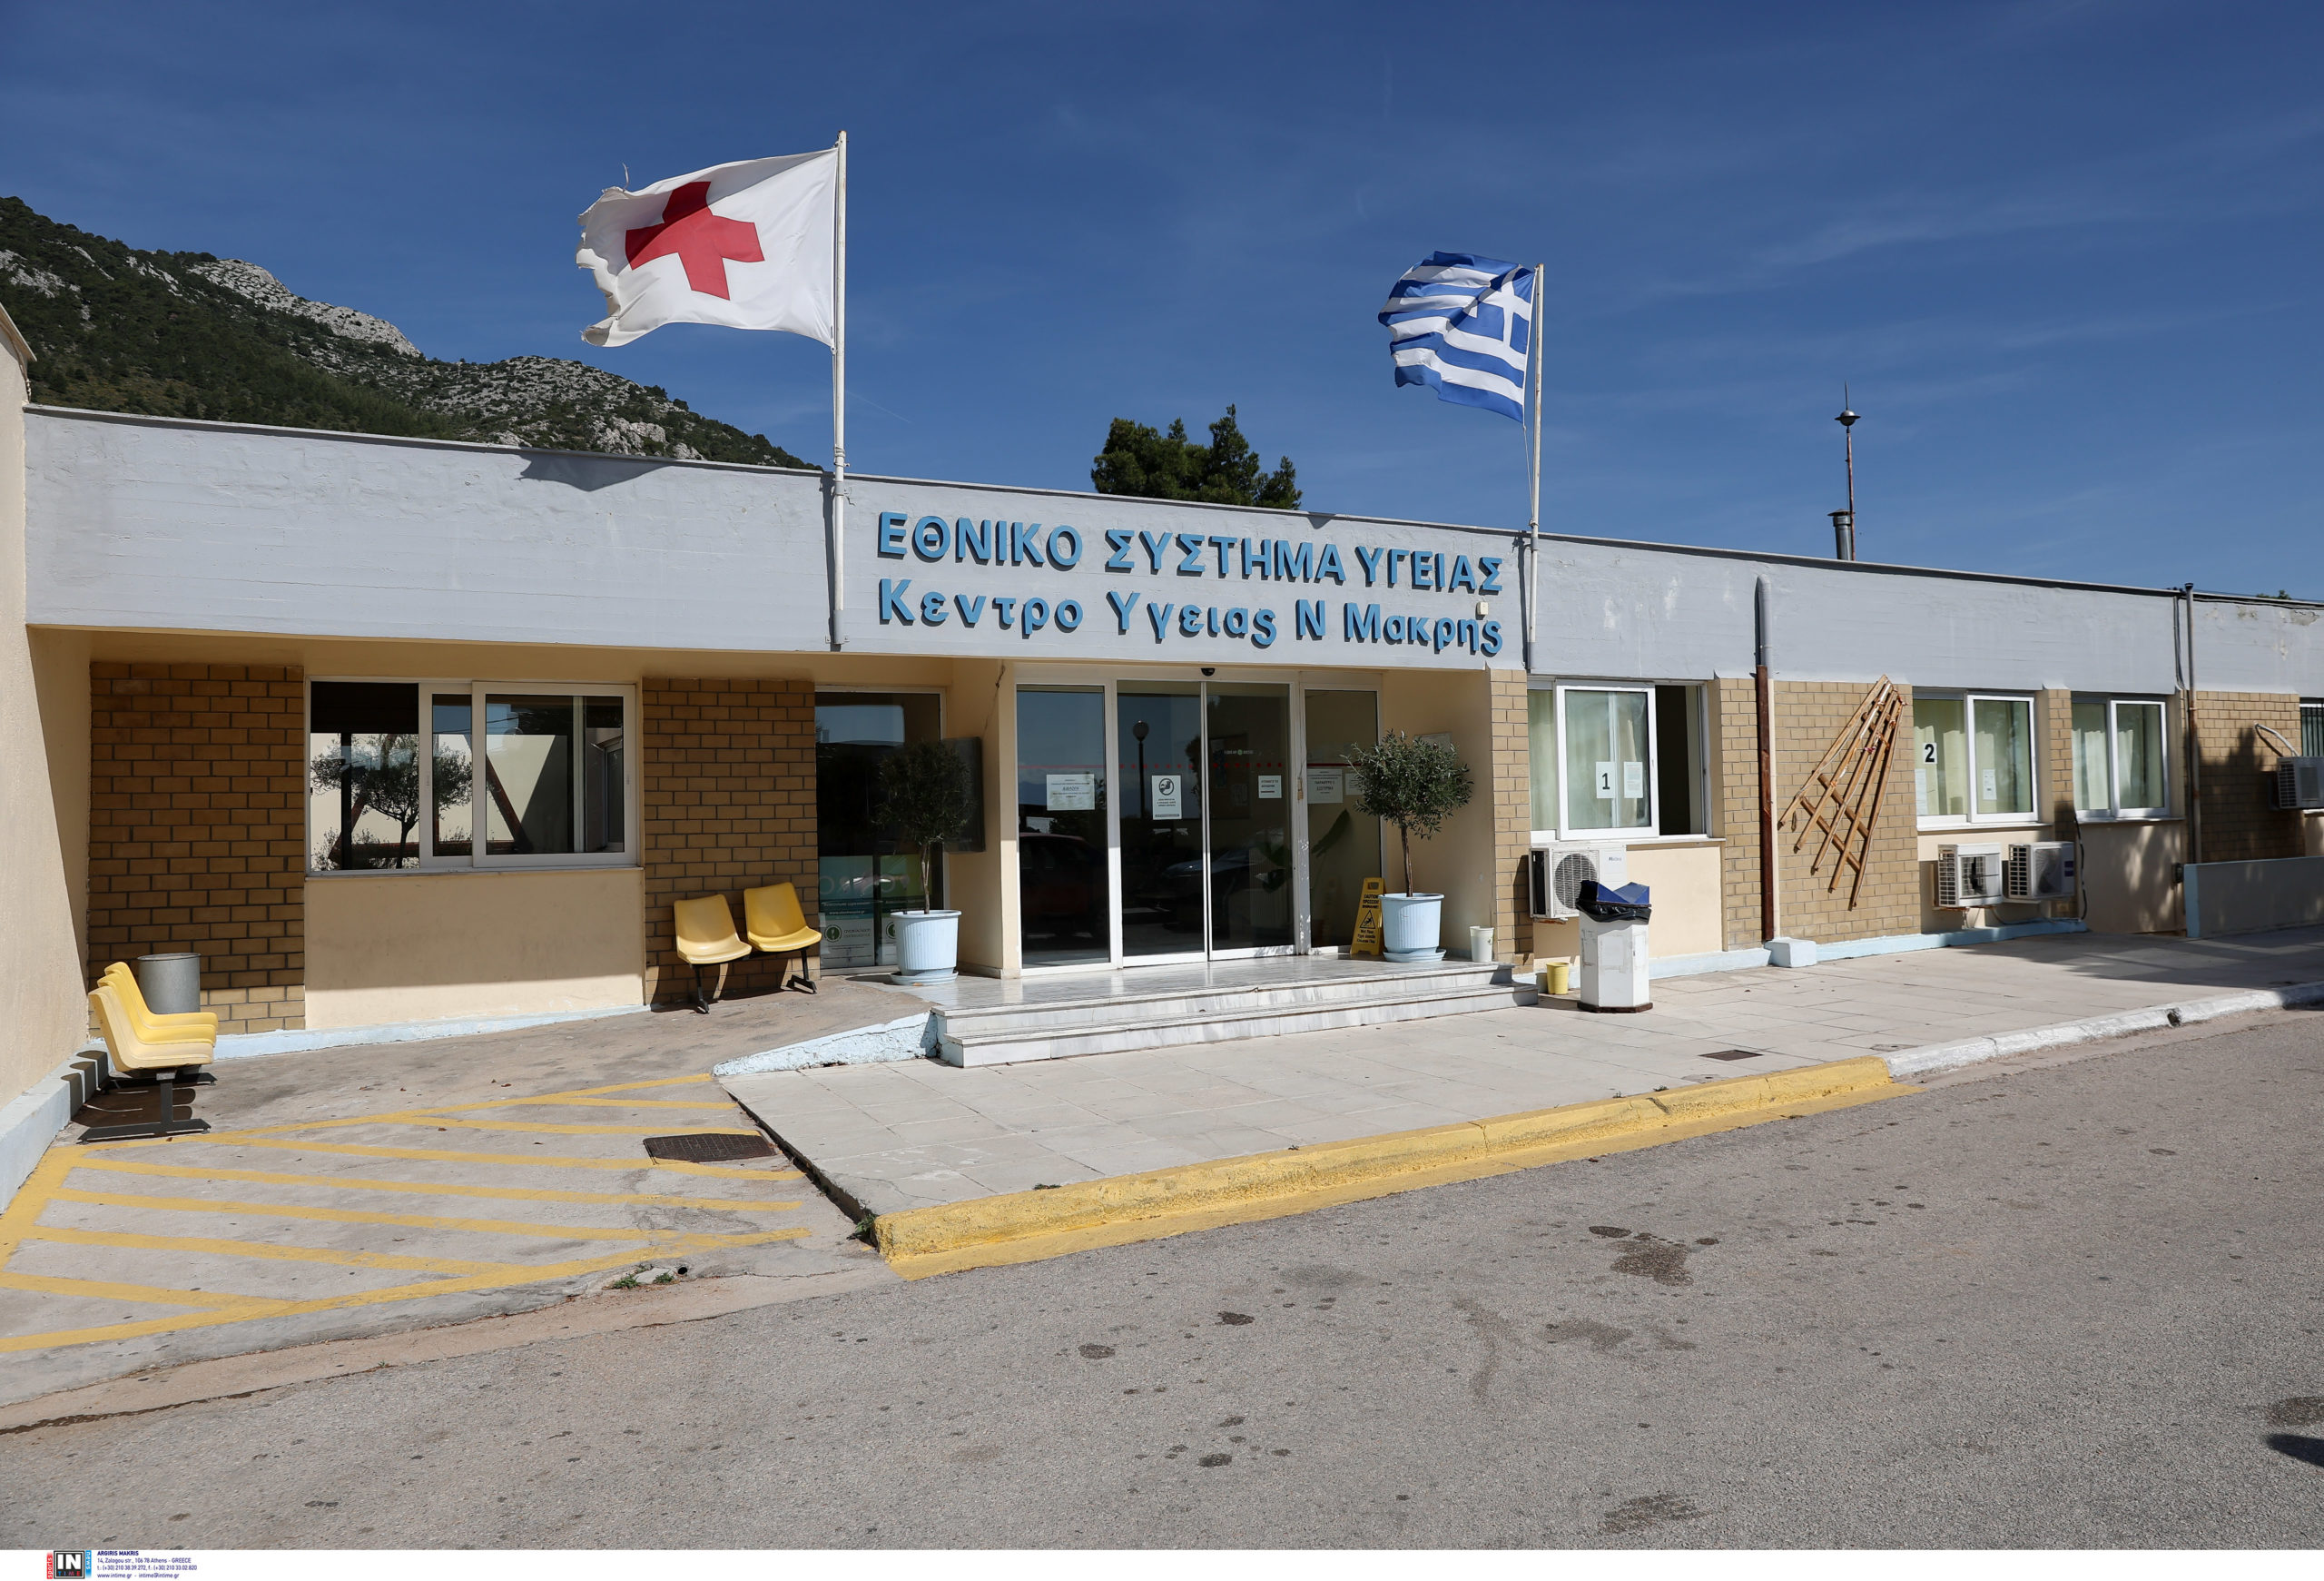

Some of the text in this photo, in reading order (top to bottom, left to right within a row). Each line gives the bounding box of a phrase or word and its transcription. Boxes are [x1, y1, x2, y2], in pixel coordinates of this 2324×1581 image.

[878, 511, 1504, 594] ΕΘΝΙΚΟ ΣΥΣΤΗΜΑ ΥΓΕΙΑΣ
[878, 578, 1083, 637] Κεντρο
[1106, 591, 1277, 647] Υγειας
[1344, 602, 1504, 656] Μακρης
[1925, 743, 1935, 763] 2
[1601, 772, 1610, 790] 1
